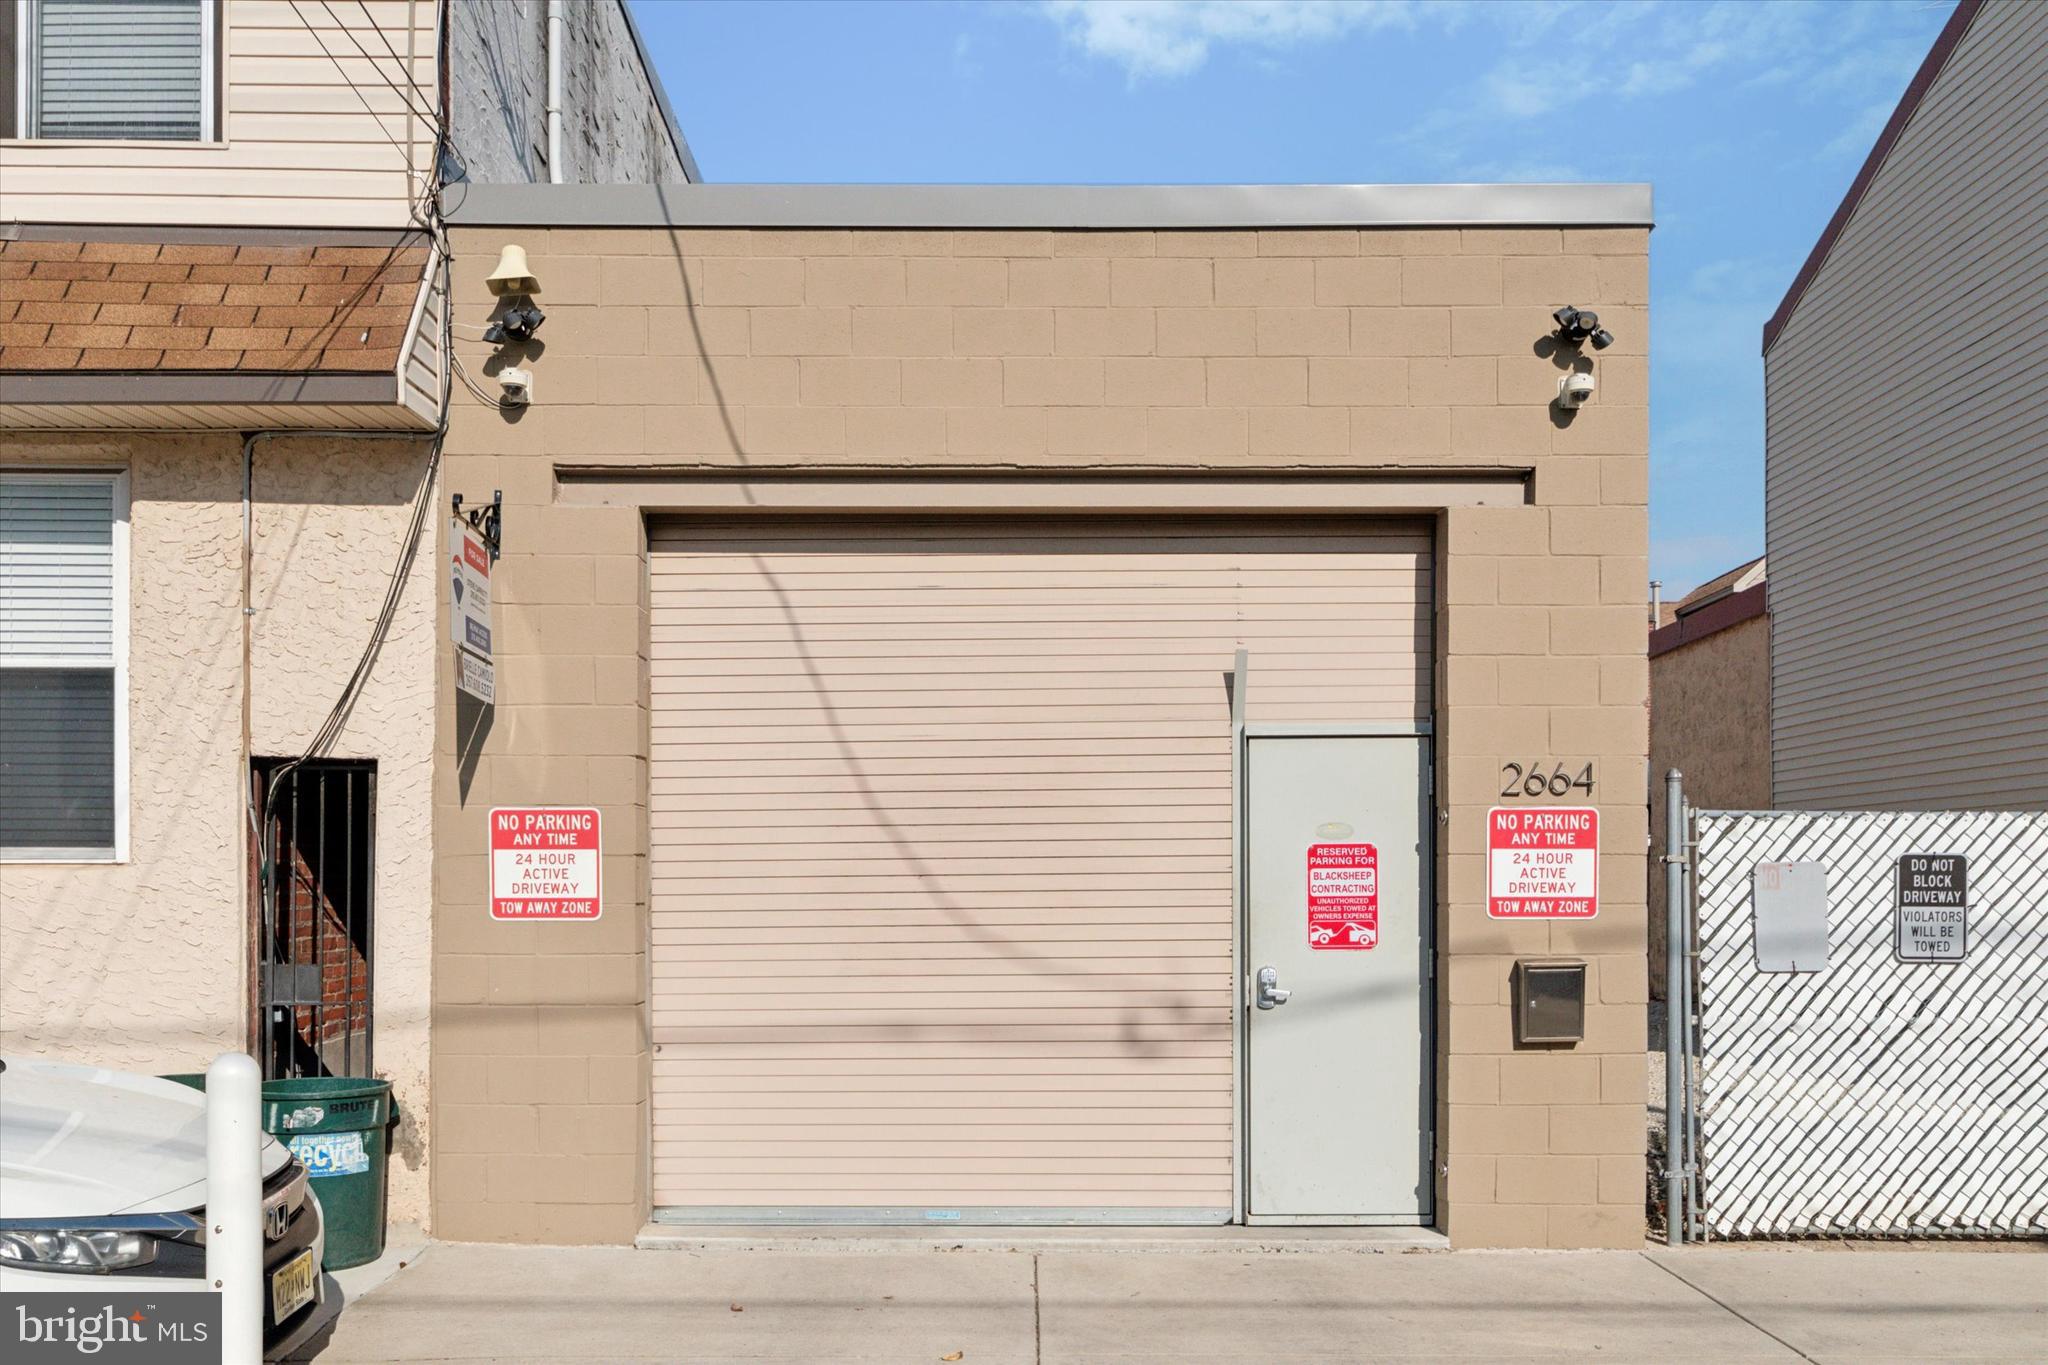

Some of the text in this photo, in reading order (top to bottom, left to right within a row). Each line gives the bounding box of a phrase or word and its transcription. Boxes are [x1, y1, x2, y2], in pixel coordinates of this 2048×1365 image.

[1501, 761, 1596, 797] 2664
[498, 814, 592, 831] NO PARKING
[1497, 814, 1590, 830] NO PARKING
[513, 833, 578, 845] ANY TIME
[1511, 833, 1576, 845] ANY TIME
[1317, 848, 1367, 856] RESERVED
[515, 853, 576, 865] 24 HOUR
[1310, 857, 1375, 865] PARKING FOR
[1513, 853, 1573, 864] 24 HOUR
[1911, 859, 1955, 871] DO NOT
[523, 868, 569, 879] ACTIVE
[1313, 871, 1372, 881] BLACKSHEEP
[1520, 868, 1566, 879] ACTIVE
[1913, 875, 1952, 887] BLOCK
[512, 883, 579, 894] DRIVEWAY
[1311, 884, 1374, 894] CONTRACTING
[1508, 882, 1576, 894] DRIVEWAY
[1903, 890, 1962, 903] DRIVEWAY
[500, 902, 593, 913] TOW AWAY ZONE
[1497, 901, 1588, 912] TOW AWAY ZONE
[1903, 911, 1962, 922] VIOLATORS
[1911, 926, 1954, 937] WILL BE
[1914, 941, 1950, 952] TOWED
[329, 1101, 375, 1114] BRUTE
